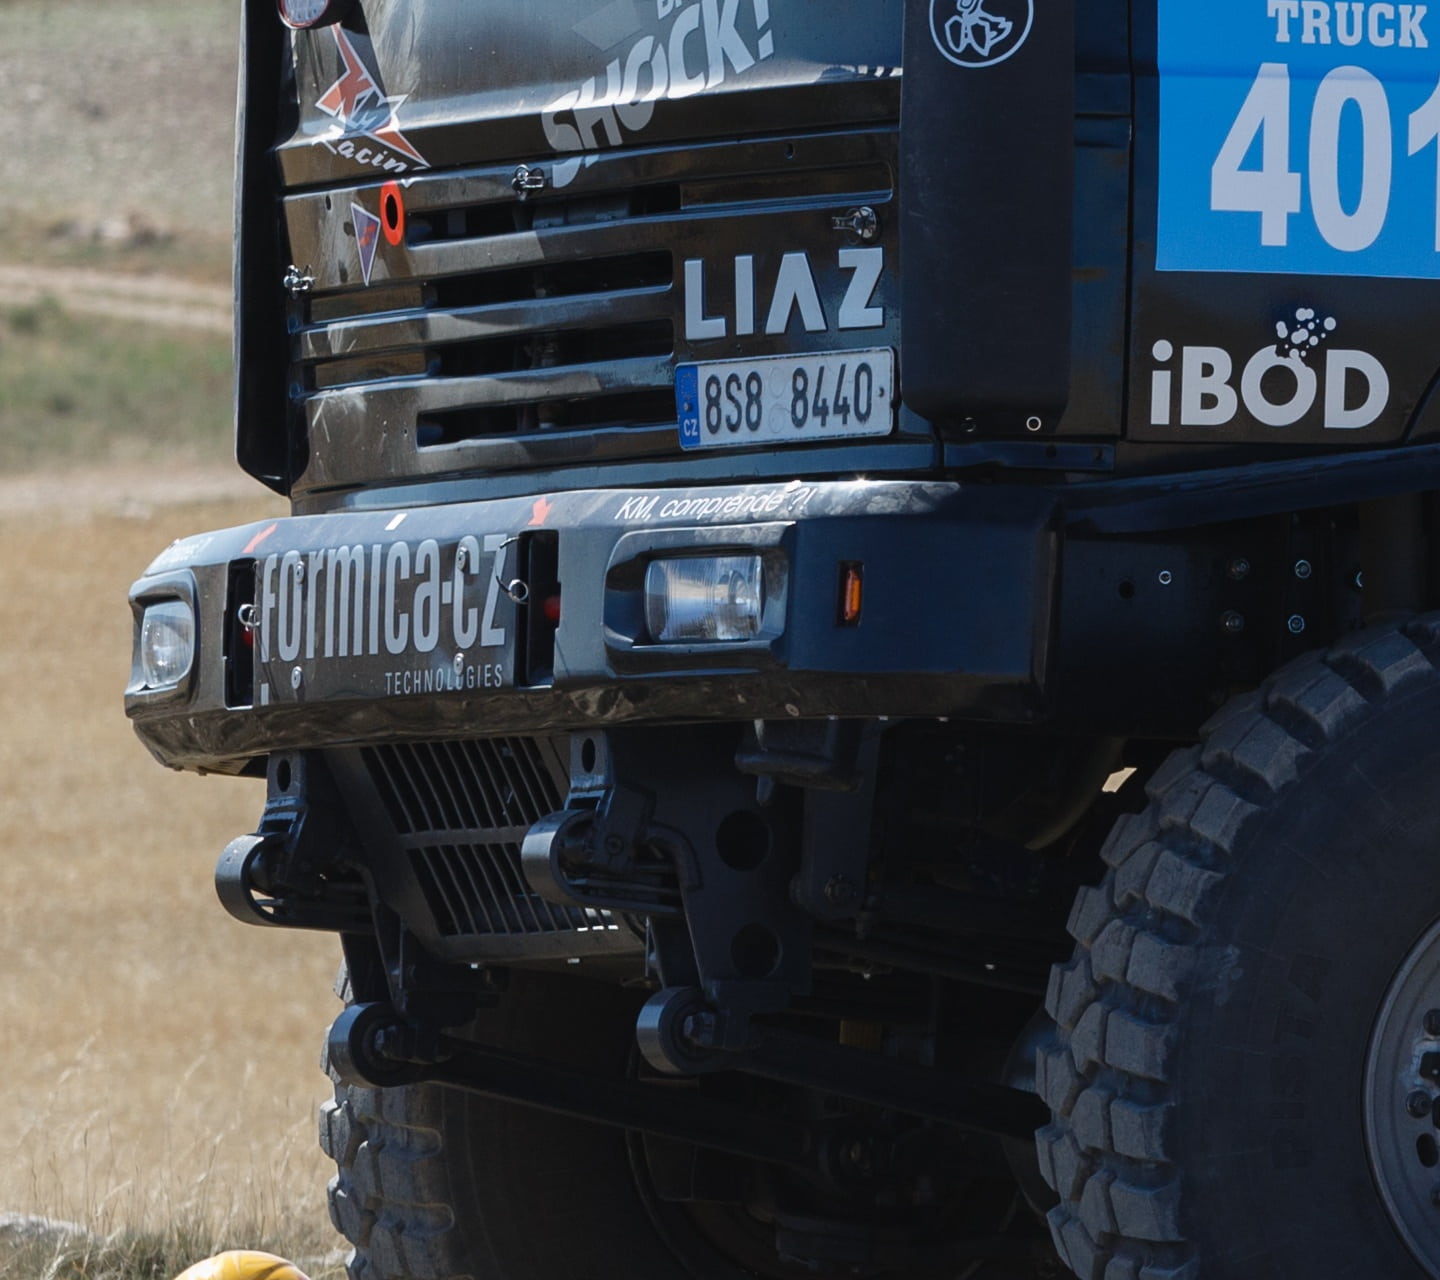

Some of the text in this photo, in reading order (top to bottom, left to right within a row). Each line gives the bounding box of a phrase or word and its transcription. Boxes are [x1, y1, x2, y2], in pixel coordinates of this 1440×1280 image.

[684, 247, 885, 341] LIAZ
[705, 361, 874, 436] 8S8 8440
[683, 418, 699, 437] CZ
[660, 489, 783, 521] comprende
[384, 662, 503, 697] TECHNOLOGIES
